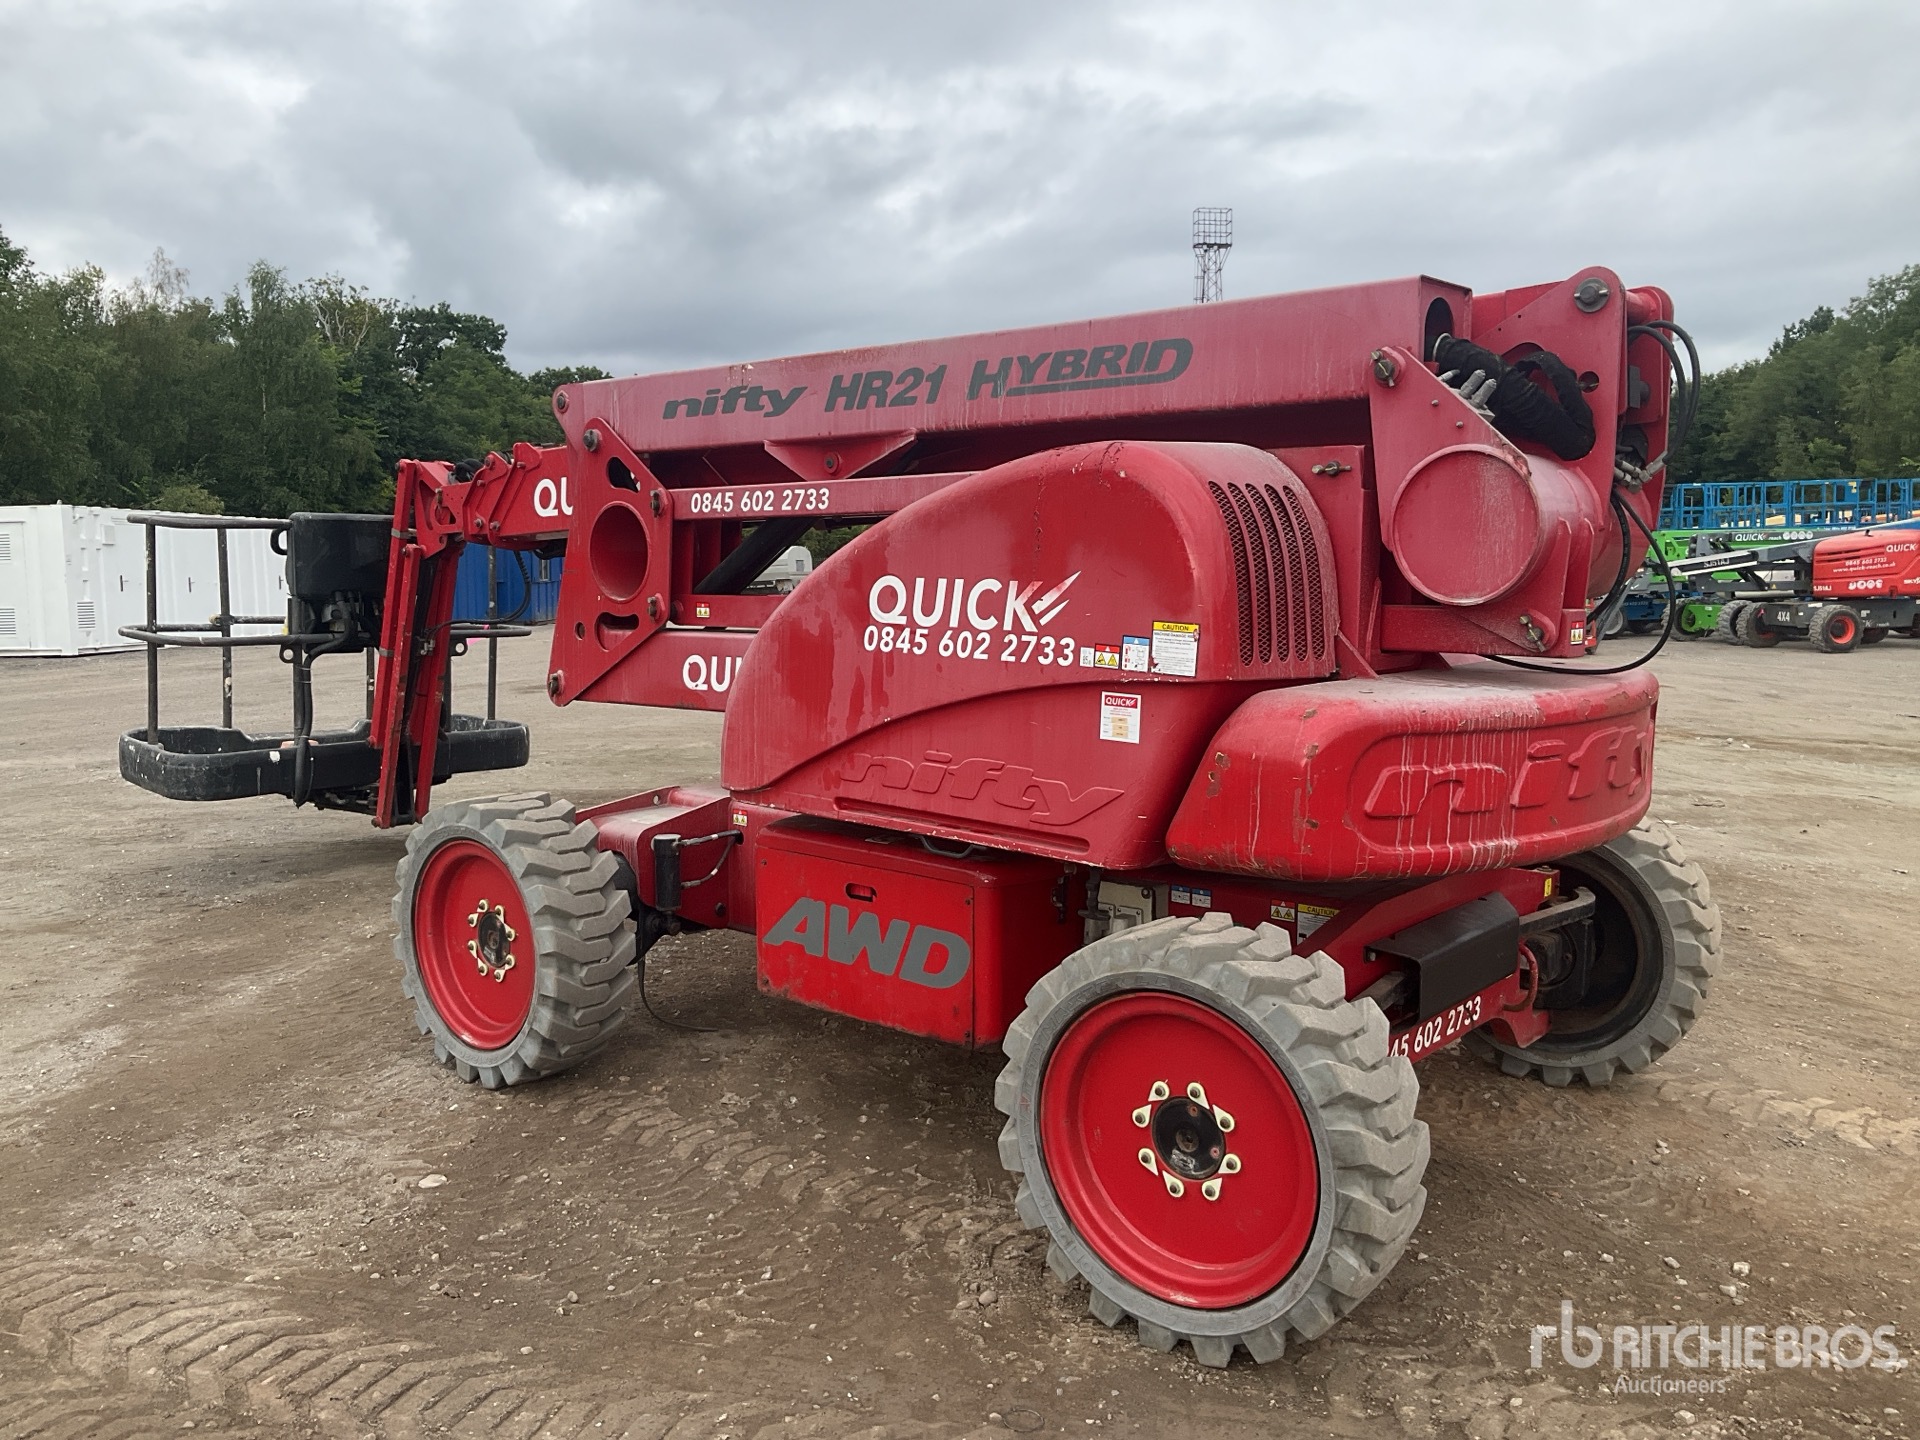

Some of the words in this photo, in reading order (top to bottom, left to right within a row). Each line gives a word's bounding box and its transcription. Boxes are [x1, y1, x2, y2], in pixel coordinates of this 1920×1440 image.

[662, 385, 808, 419] nifty
[825, 365, 946, 412] HR21
[967, 339, 1193, 398] HYBRID
[690, 491, 734, 514] 0845
[741, 489, 775, 512] 602
[782, 487, 830, 511] 2733
[1735, 533, 1765, 542] QUICK
[1886, 543, 1917, 553] QUICK
[869, 571, 1081, 632] QUICK
[1161, 623, 1190, 631] CAUTION
[1776, 611, 1790, 622] 4X4
[863, 625, 929, 655] 0845
[938, 629, 991, 660] 602
[1000, 633, 1075, 667] 2733
[1105, 696, 1136, 707] QUICK
[839, 750, 1125, 827] nifty
[1307, 906, 1336, 917] CAUTION
[764, 898, 971, 988] AWD
[1413, 1016, 1443, 1053] 602
[1446, 995, 1482, 1036] 2733
